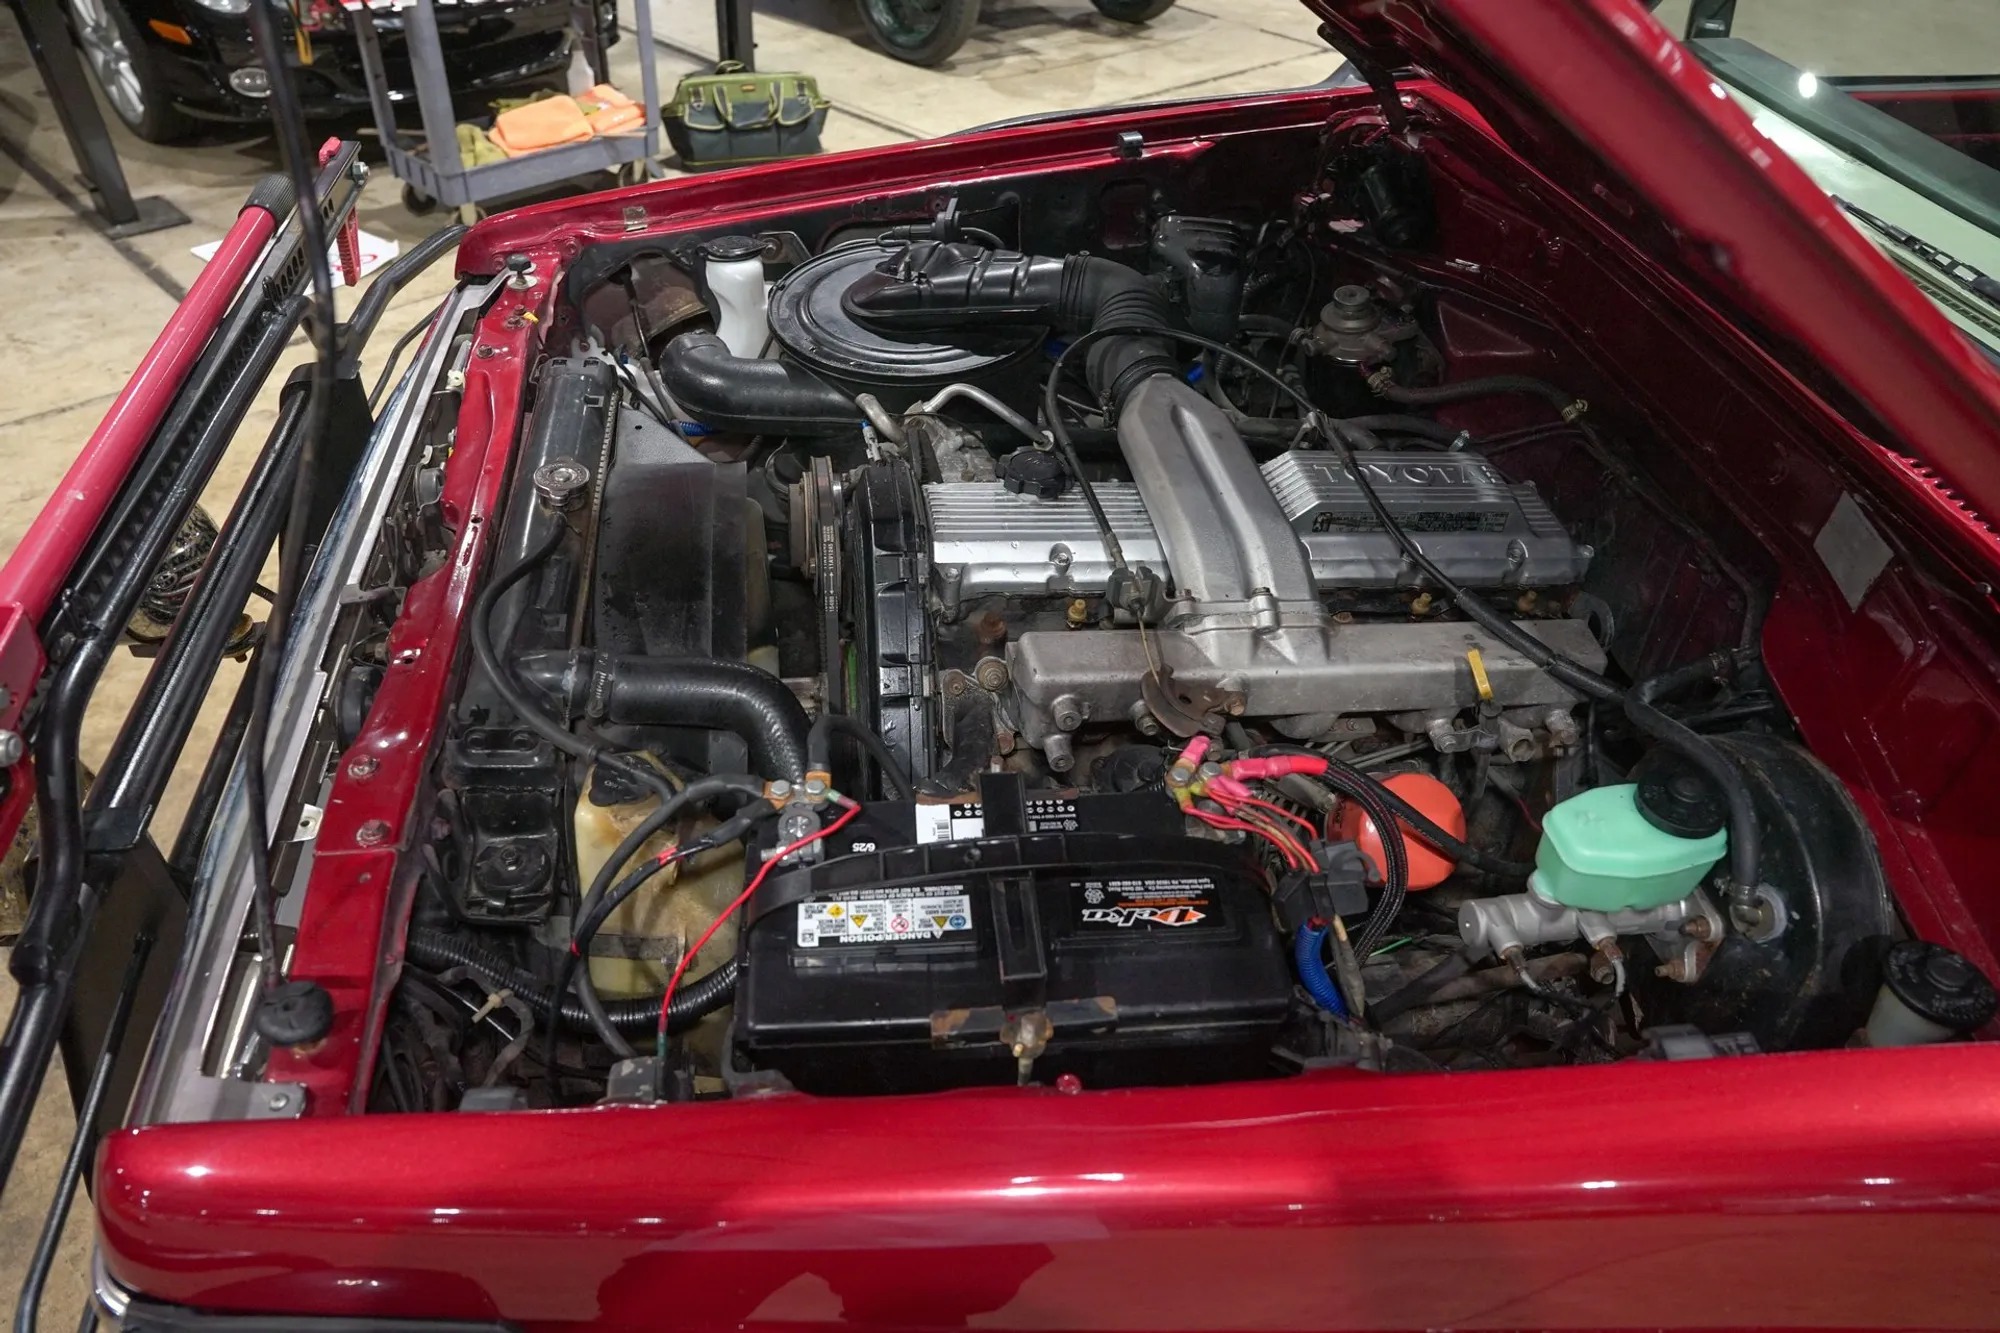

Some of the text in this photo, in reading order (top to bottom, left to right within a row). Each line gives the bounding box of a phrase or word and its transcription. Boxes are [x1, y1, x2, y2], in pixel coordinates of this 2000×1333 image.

[1313, 463, 1488, 484] TOYOTA
[852, 842, 876, 853] 6/25
[1083, 906, 1207, 927] Deka
